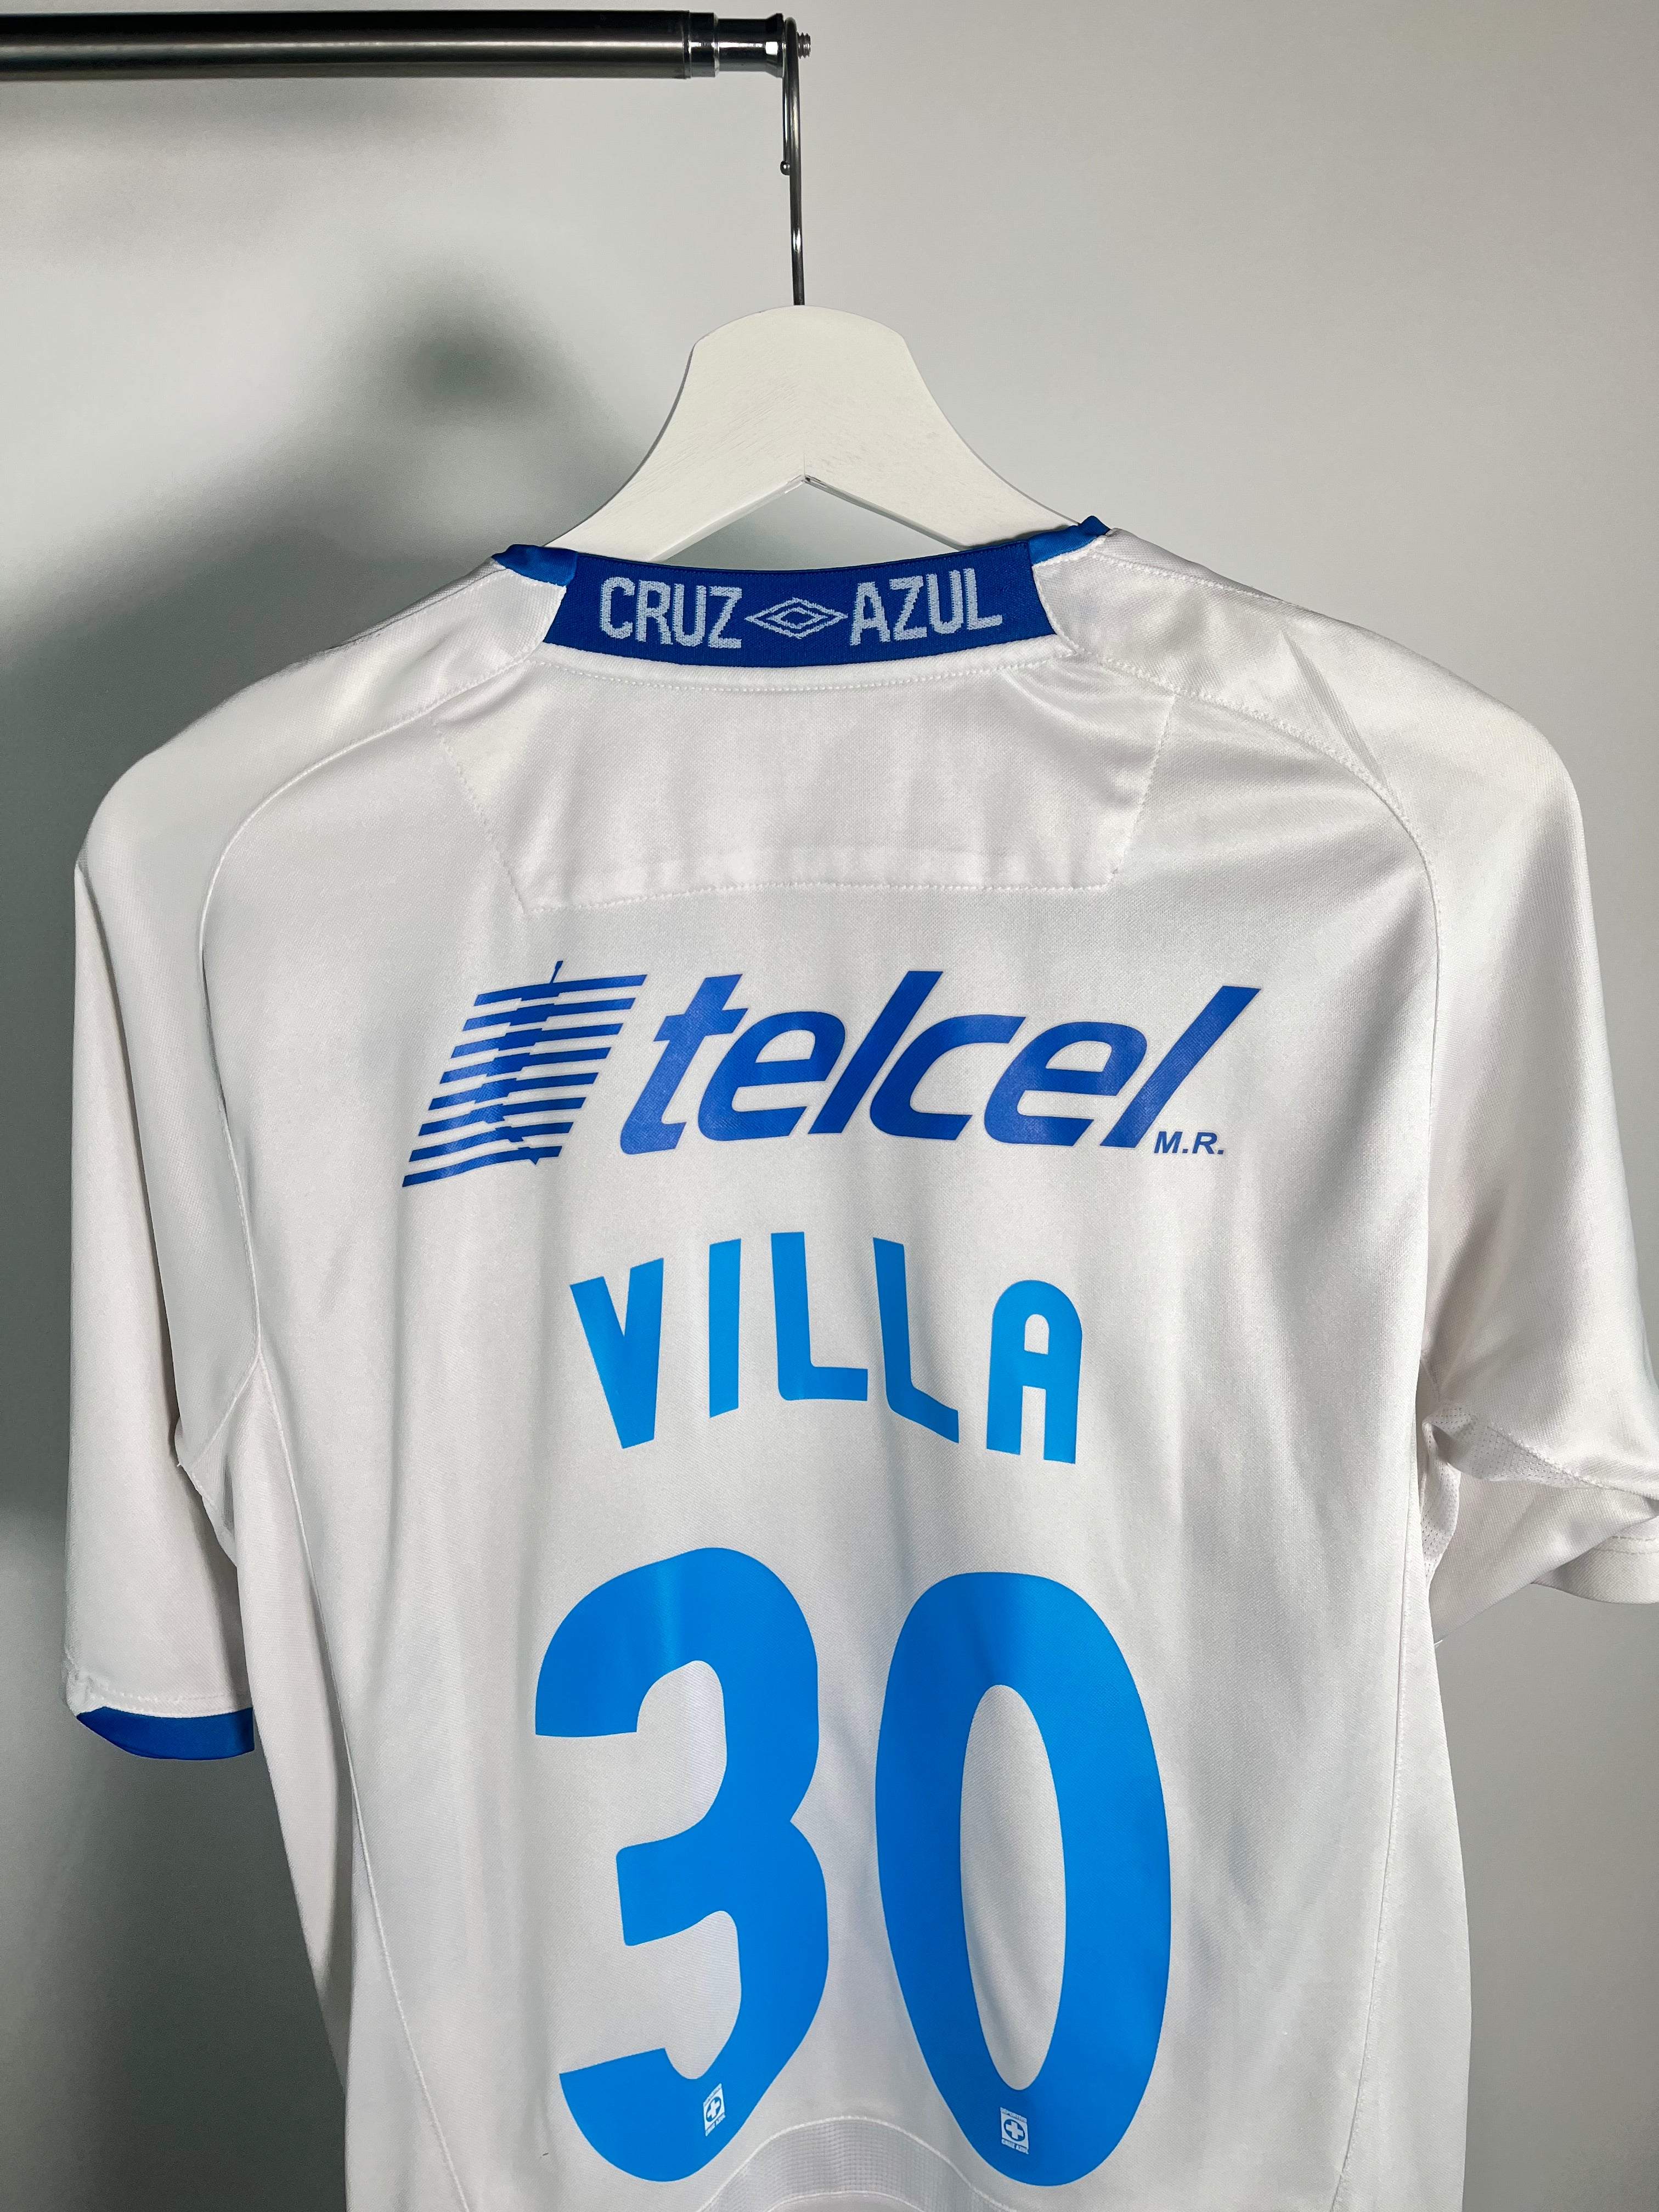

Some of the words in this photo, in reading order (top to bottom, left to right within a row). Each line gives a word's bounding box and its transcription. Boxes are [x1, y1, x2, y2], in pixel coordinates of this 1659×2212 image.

[599, 576, 743, 649] CRUZ
[849, 567, 1003, 646] AZUL
[620, 971, 1259, 1154] telcel
[1154, 1131, 1224, 1155] M.R.
[570, 1232, 1082, 1464] VILLA
[535, 1548, 1171, 2187] 30
